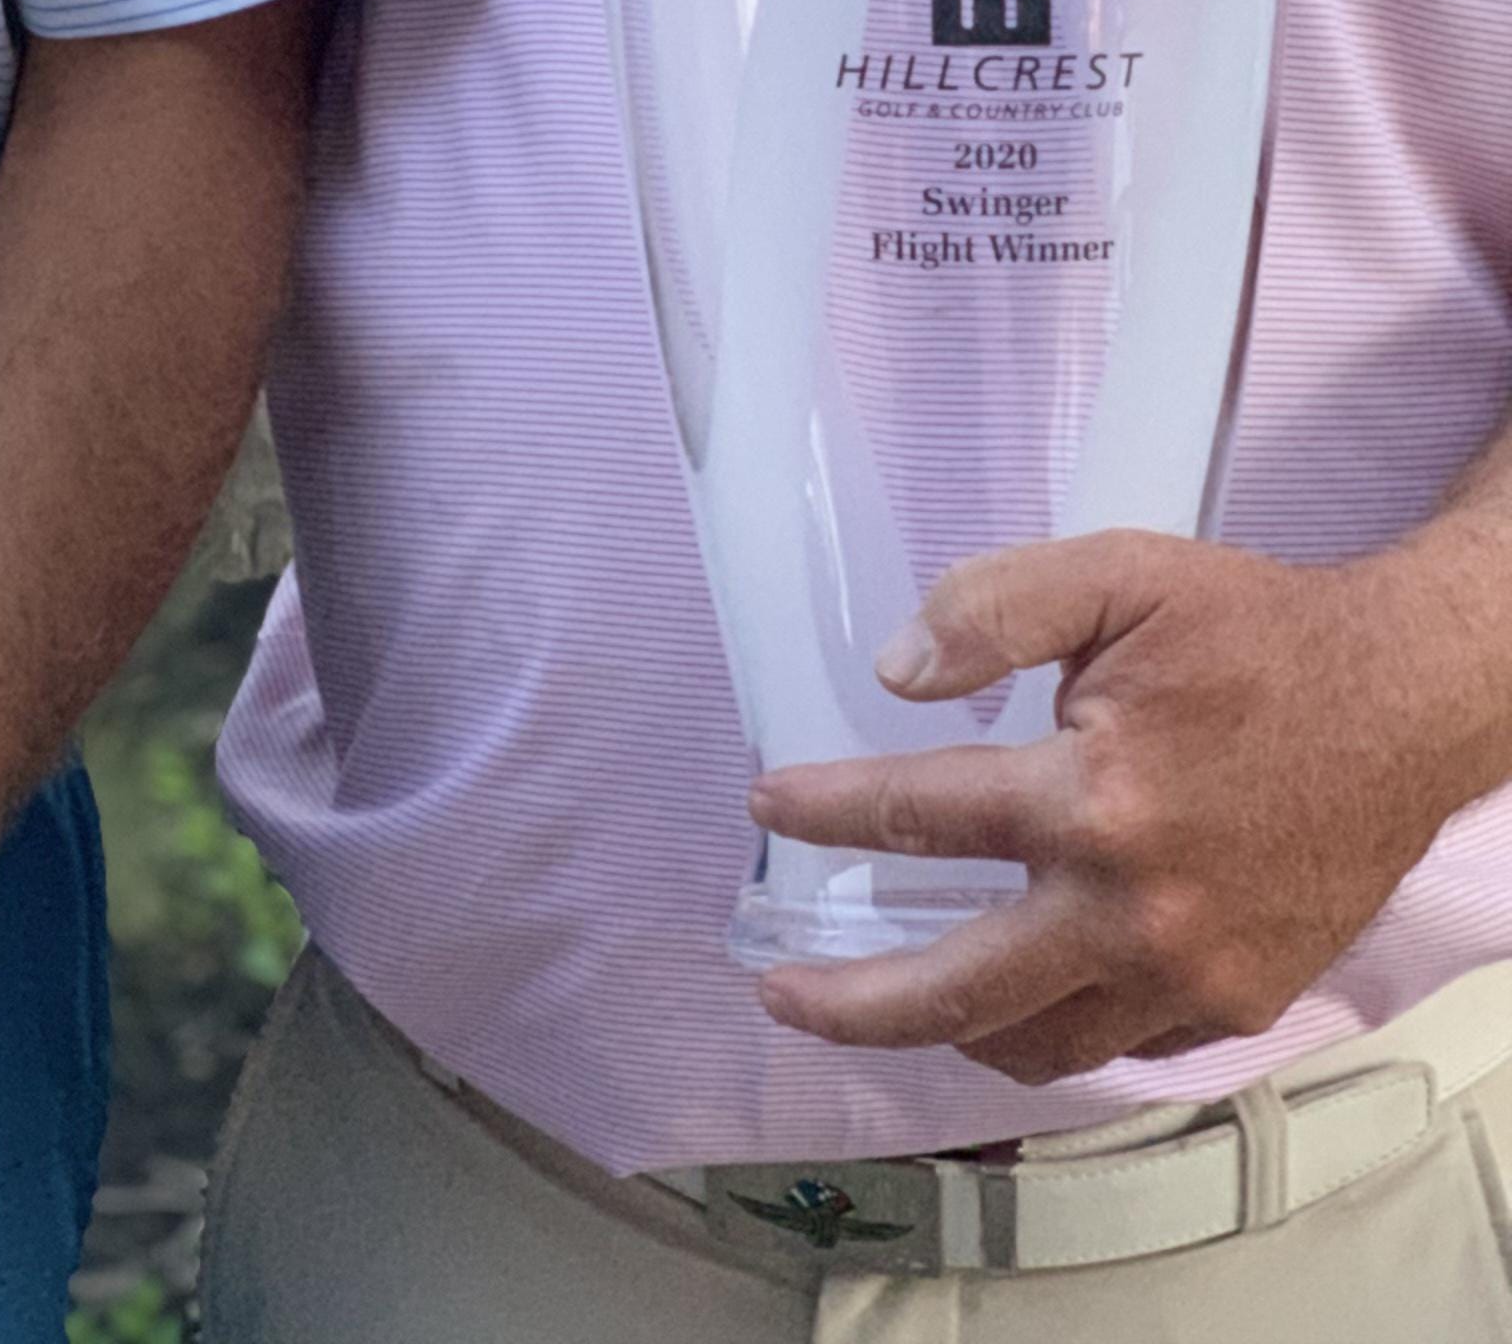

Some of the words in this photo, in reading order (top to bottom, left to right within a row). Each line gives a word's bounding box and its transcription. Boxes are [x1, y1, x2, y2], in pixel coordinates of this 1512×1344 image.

[835, 52, 1145, 92] HILLCREST
[857, 100, 923, 119] GOLF
[927, 101, 942, 119] &
[950, 102, 1068, 120] COUNTRY
[1071, 100, 1124, 119] CLUB
[953, 143, 1038, 171] 2020
[922, 186, 1070, 227] Swinger
[871, 230, 976, 270] Flight
[987, 233, 1115, 264] Winner
